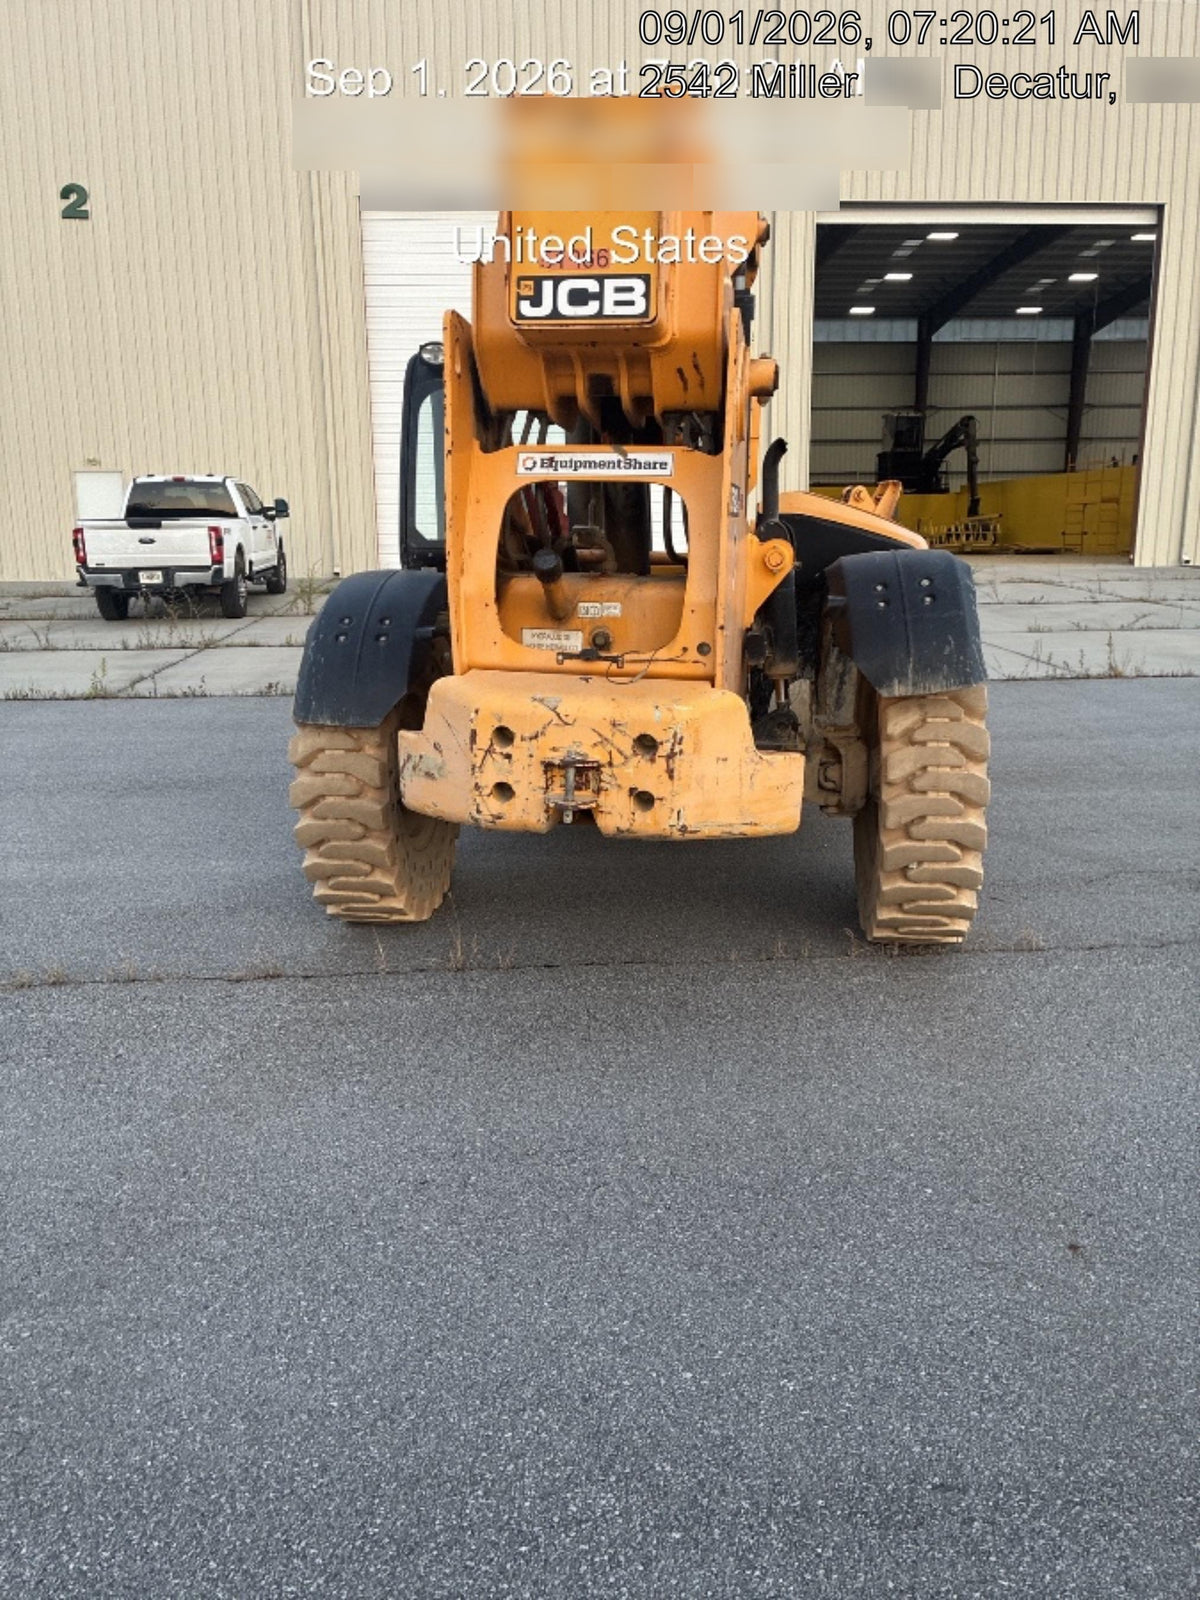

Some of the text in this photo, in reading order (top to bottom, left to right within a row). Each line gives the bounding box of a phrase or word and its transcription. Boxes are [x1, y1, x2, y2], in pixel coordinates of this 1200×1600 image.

[60, 183, 89, 219] 2
[519, 278, 647, 317] JCB
[540, 457, 668, 472] EquipmentShare
